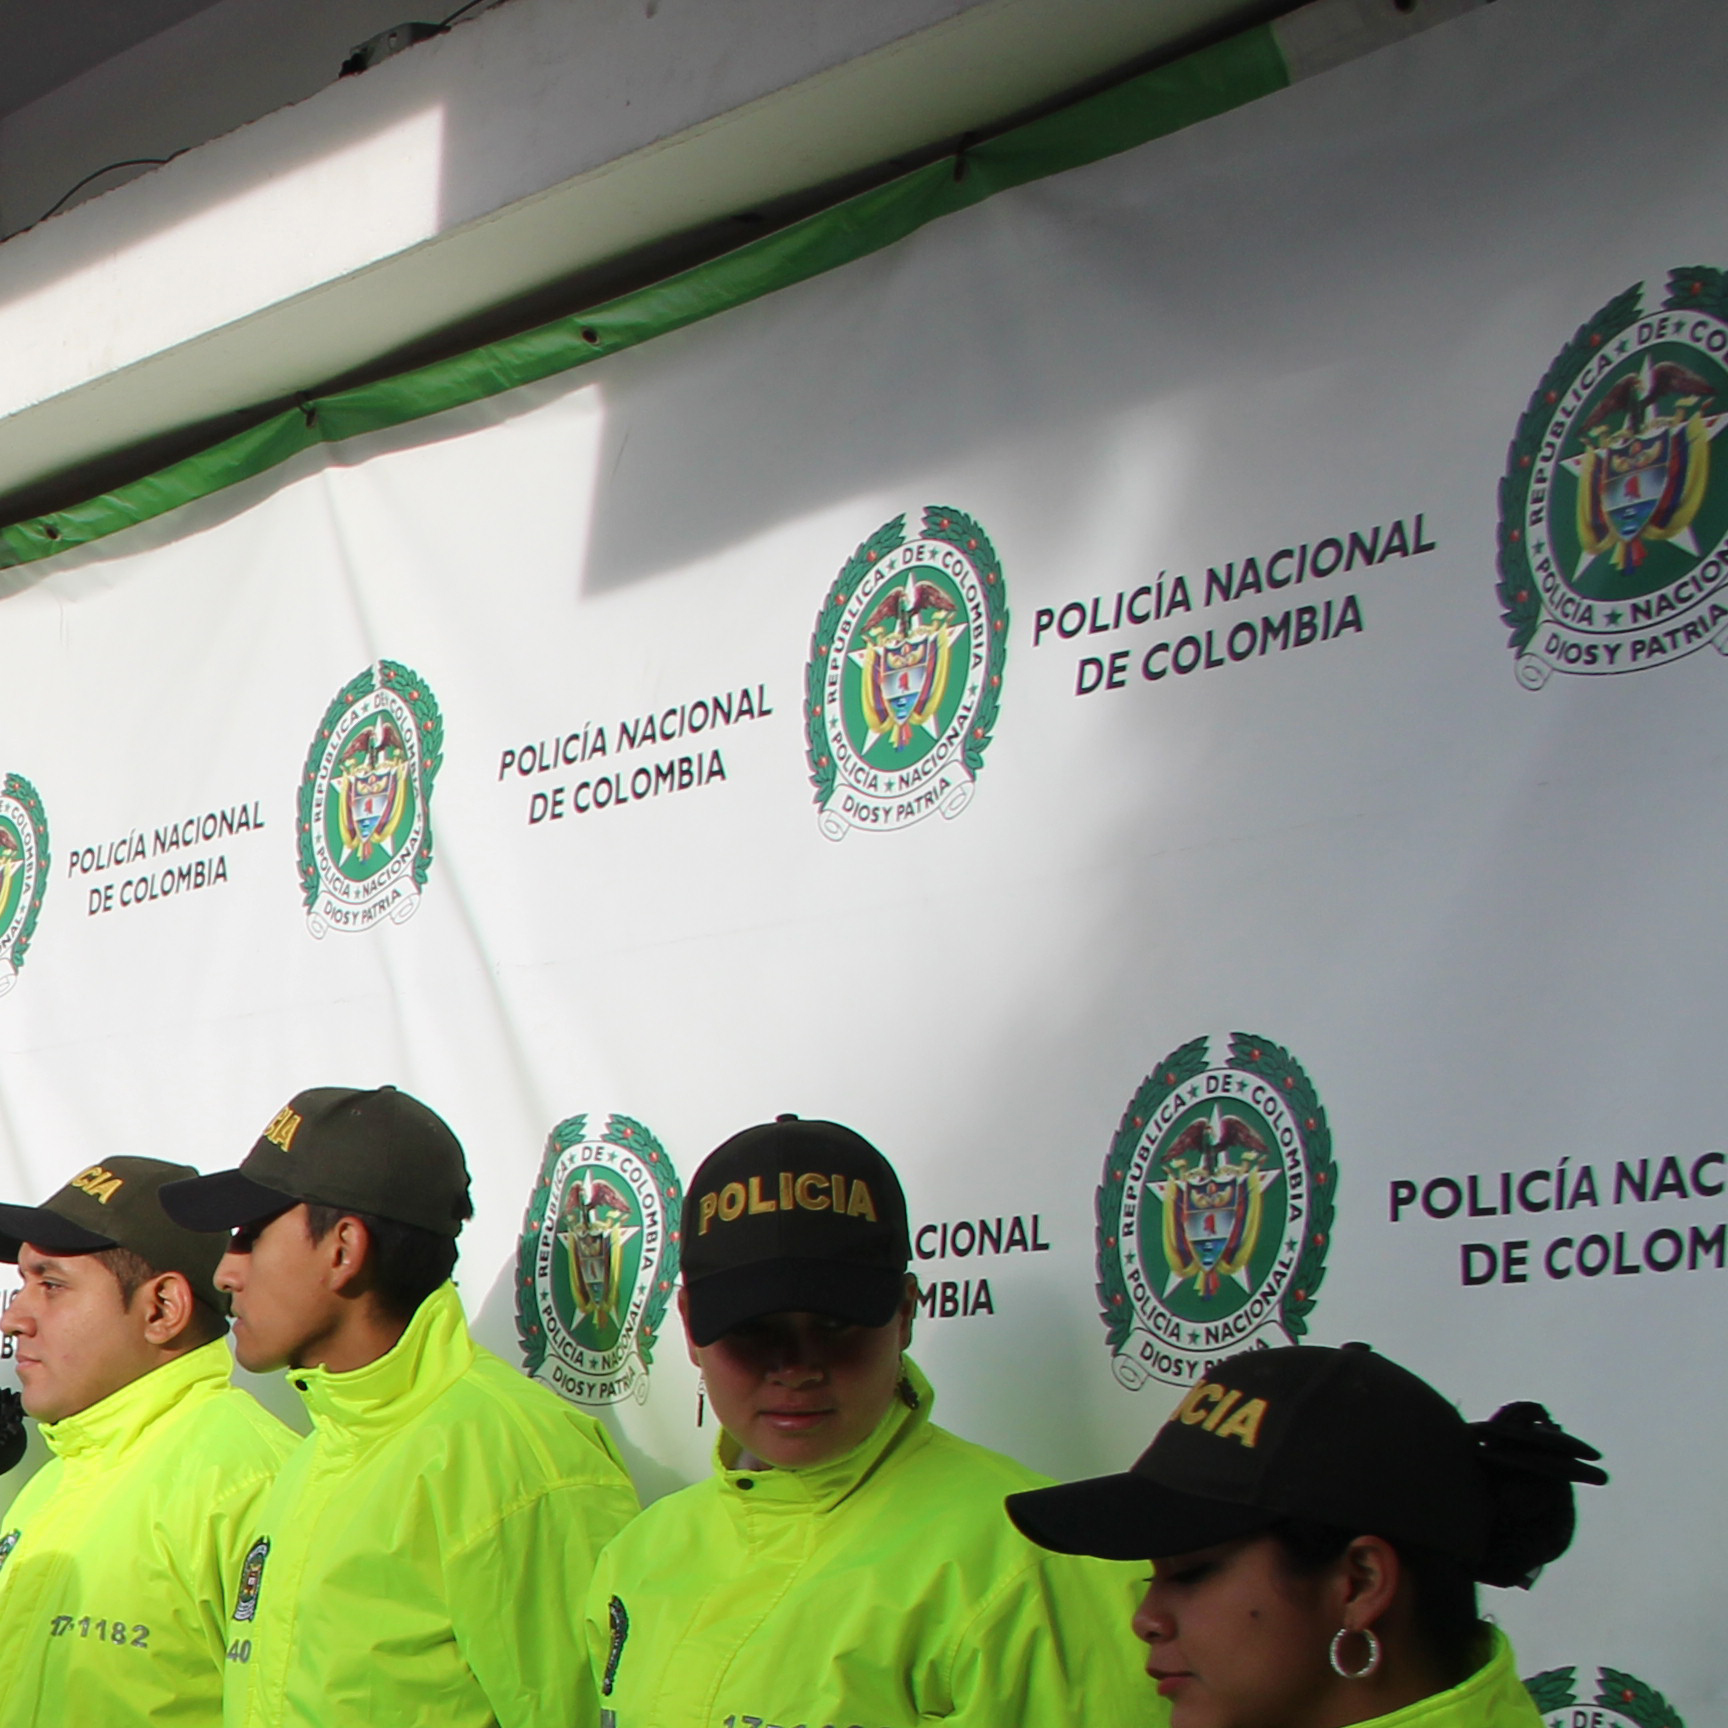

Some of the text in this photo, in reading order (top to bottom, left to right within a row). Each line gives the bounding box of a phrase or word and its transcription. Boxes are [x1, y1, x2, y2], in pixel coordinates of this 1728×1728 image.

[1636, 317, 1670, 345] DE
[901, 543, 925, 566] DE
[942, 550, 986, 671] COLOMBIA
[1031, 512, 1437, 648] POLICÍA NACIONAL
[1629, 549, 1728, 625] NACIO
[1074, 593, 1364, 697] DE COLOMBIA
[1543, 631, 1599, 666] DIOS
[497, 683, 774, 782] POLICÍA NACIONAL
[897, 700, 974, 792] NACIONAL
[527, 748, 728, 826] DE COLOMBIA
[840, 793, 881, 825] DIOS
[895, 776, 952, 823] PATRIA
[67, 800, 267, 879] POLICÍA NACIONAL
[361, 823, 422, 900] NACIONAL
[87, 854, 230, 917] DE COLOMBIA
[360, 887, 403, 924] PATRIA
[1205, 1074, 1234, 1094] DE
[1250, 1085, 1304, 1224] COLOMBIA
[580, 1145, 604, 1163] DE
[618, 1156, 660, 1272] COLOMBIA
[697, 1172, 878, 1237] POLICIA
[1388, 1155, 1600, 1224] POLICÍA
[1459, 1223, 1728, 1287] DE COLOM
[1203, 1254, 1295, 1347] NACIONAL
[551, 1365, 586, 1398] DIOS
[599, 1366, 637, 1399] PATRIA
[1139, 1339, 1185, 1379] DIOS
